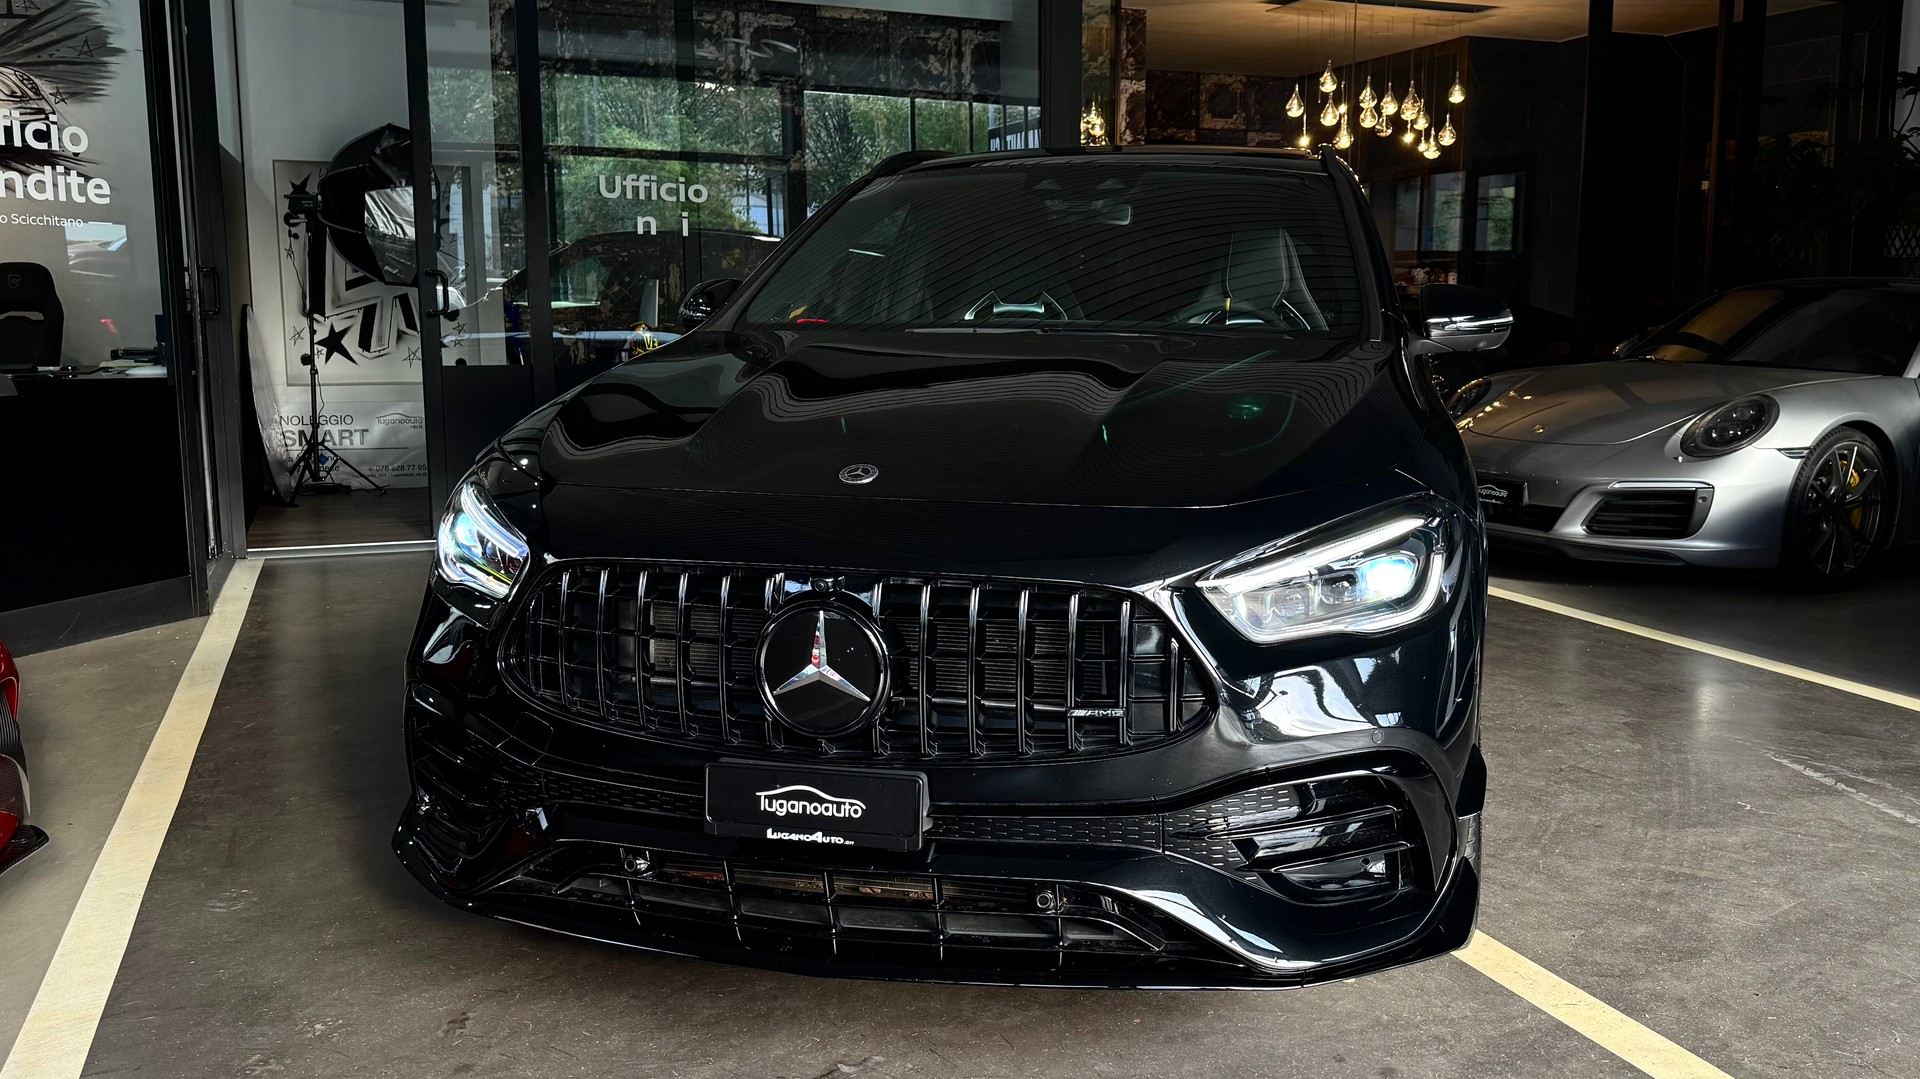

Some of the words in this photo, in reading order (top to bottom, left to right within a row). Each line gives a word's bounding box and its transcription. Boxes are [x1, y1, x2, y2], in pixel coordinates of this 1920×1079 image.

[599, 174, 708, 203] Ufficio
[11, 213, 84, 227] Scicchitano
[1085, 708, 1124, 717] AMG
